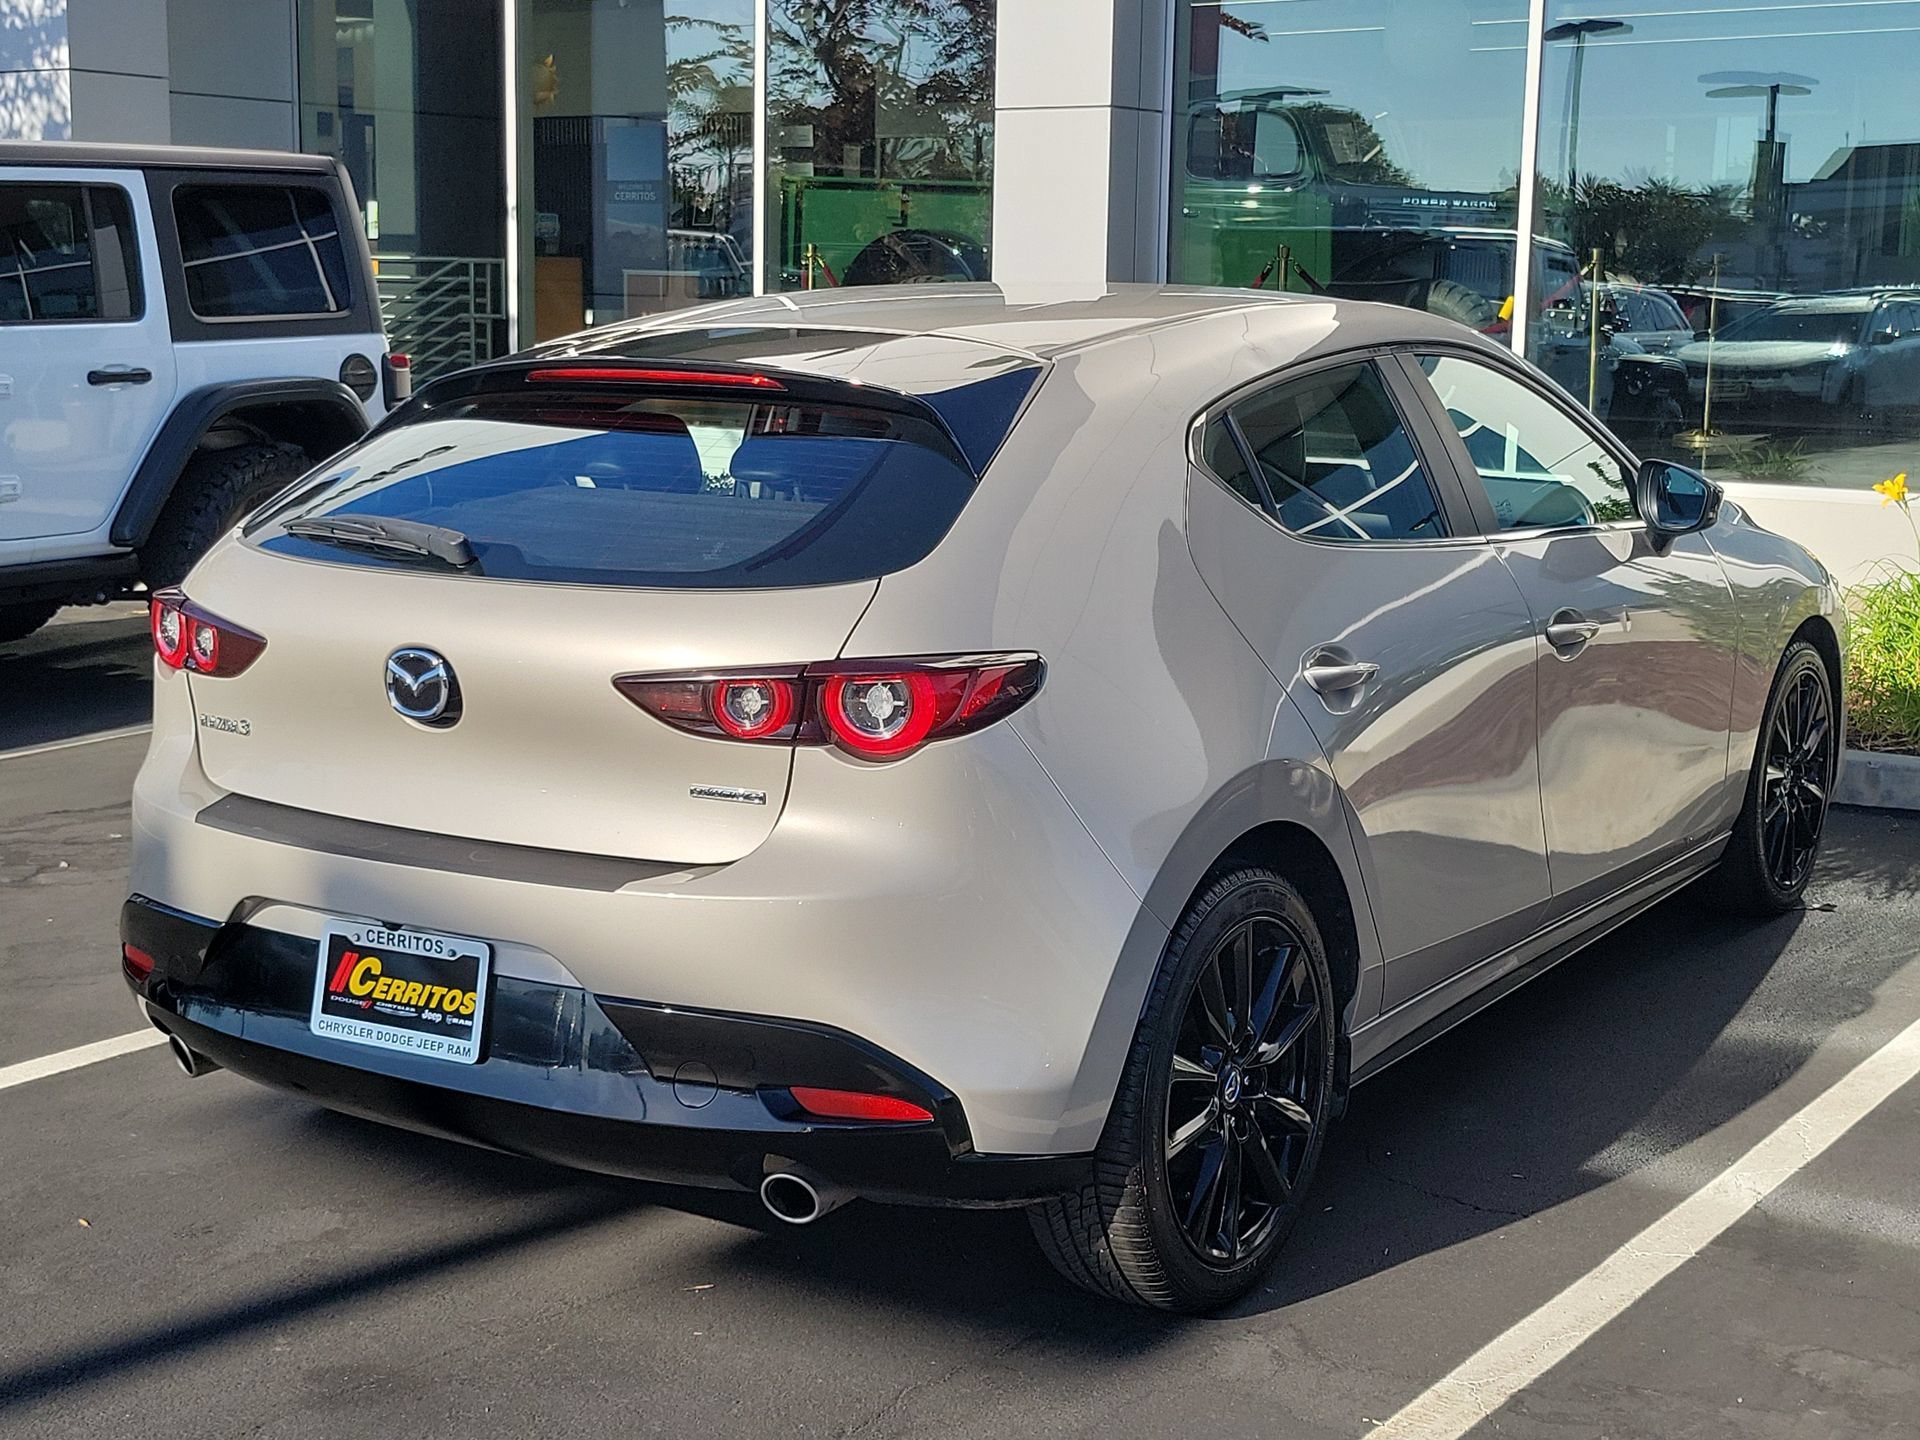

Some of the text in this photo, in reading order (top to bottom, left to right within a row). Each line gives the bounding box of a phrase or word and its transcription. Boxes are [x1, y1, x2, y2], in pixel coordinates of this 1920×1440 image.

[614, 191, 656, 201] CERRITOS
[1402, 196, 1497, 210] POWER WAGON
[366, 929, 444, 955] CERRITOS
[348, 956, 477, 1015] CERRITOS
[330, 995, 473, 1026] DODGE CHRYSLER Jeep RAM
[318, 1019, 472, 1058] CHRYSLER DODGE JEEP RAM
